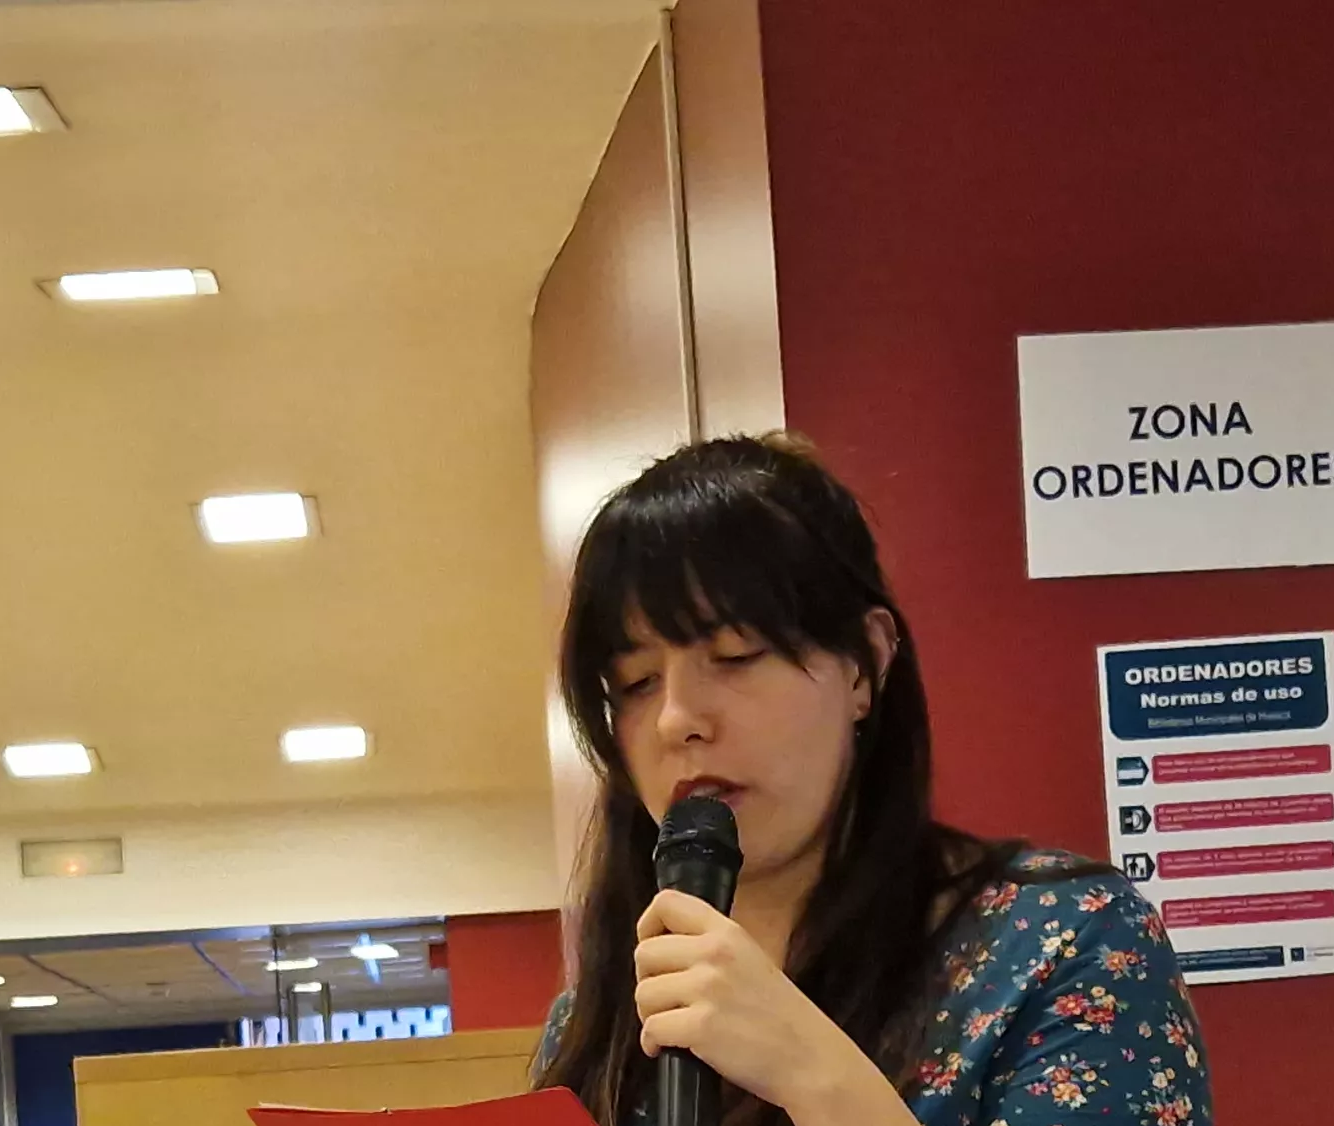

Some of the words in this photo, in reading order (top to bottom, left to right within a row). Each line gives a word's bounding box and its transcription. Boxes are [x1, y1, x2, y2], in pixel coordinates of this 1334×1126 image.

[1128, 401, 1253, 440] ZONA
[1125, 657, 1314, 685] ORDENADORES
[1140, 692, 1225, 709] Normas
[1231, 687, 1258, 702] de
[1264, 686, 1302, 700] uso
